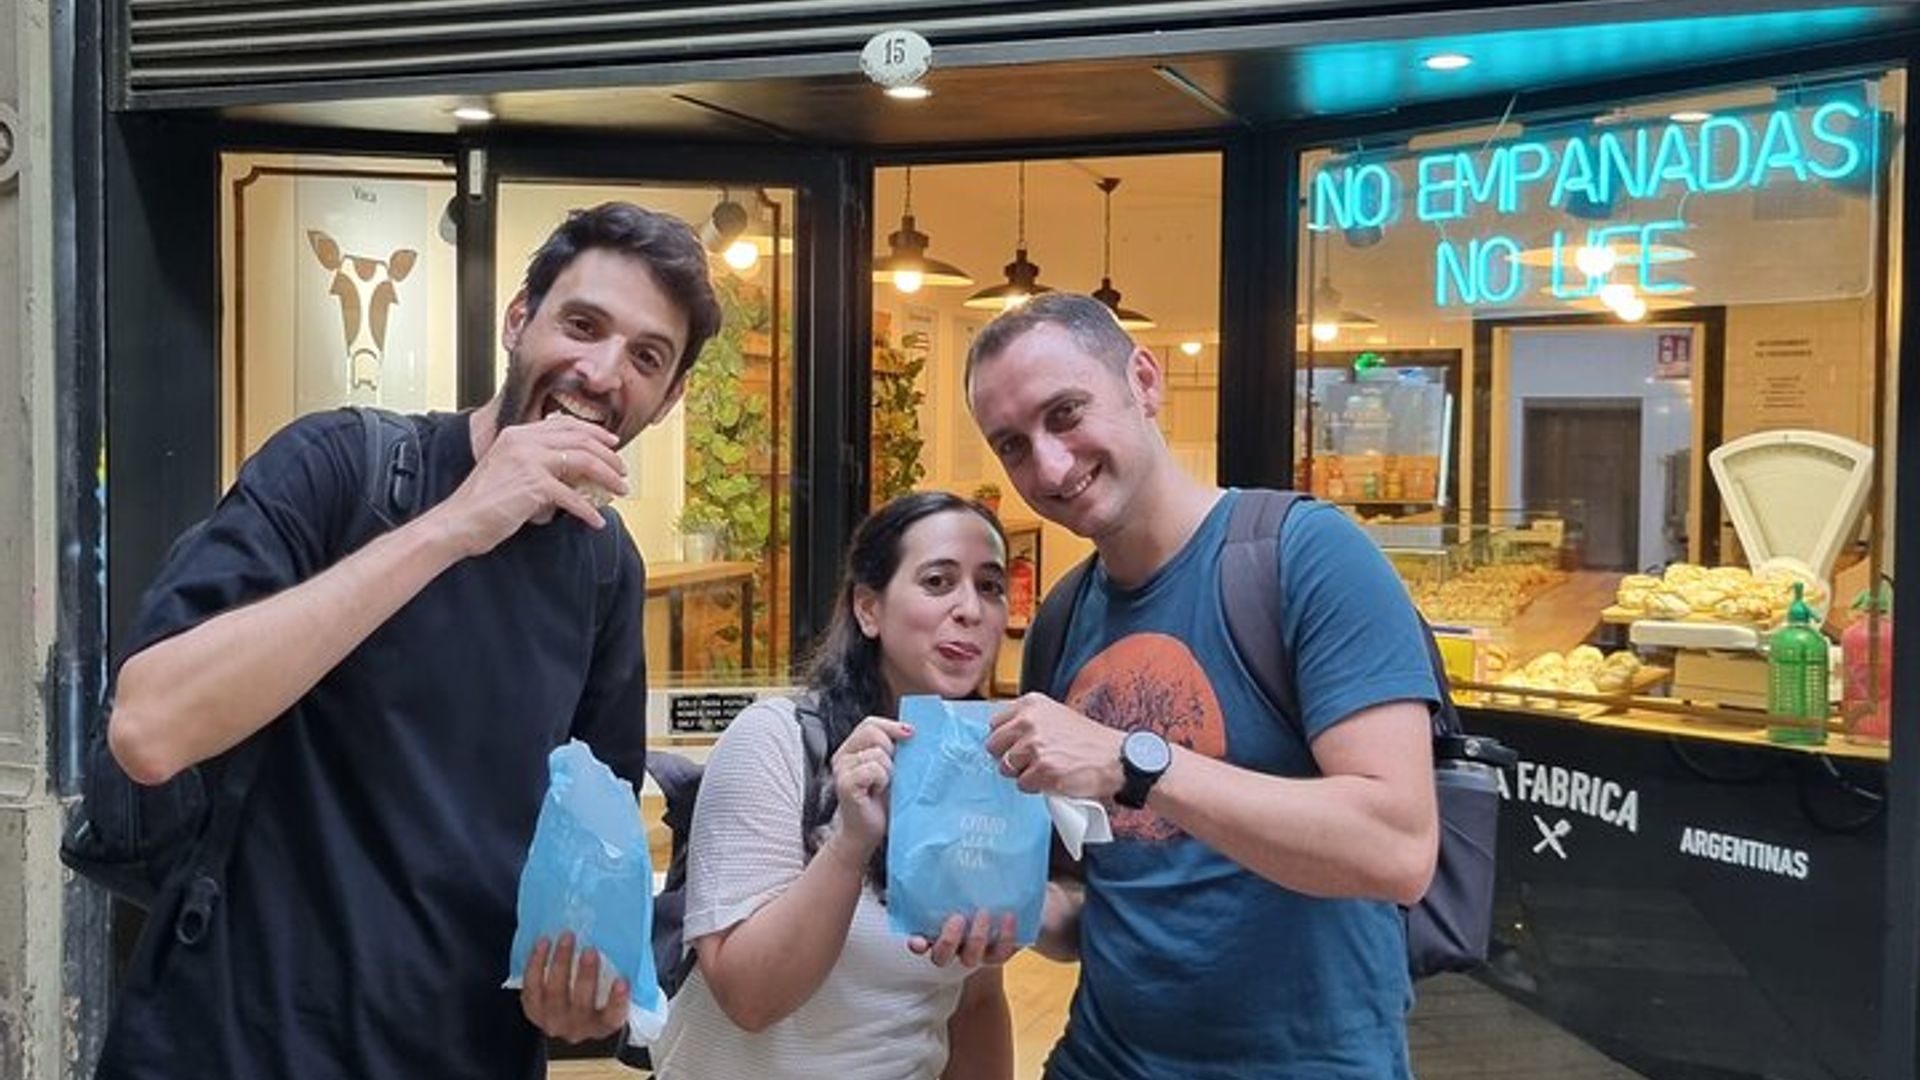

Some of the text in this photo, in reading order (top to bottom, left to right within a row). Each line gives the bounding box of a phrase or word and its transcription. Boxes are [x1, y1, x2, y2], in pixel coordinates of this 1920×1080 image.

[885, 38, 905, 64] 15
[1313, 102, 1862, 229] NO EMPANADAS
[1435, 218, 1695, 306] NO LIFE
[1517, 761, 1639, 832] FABRICA
[1680, 828, 1809, 879] ARGENTINAS
